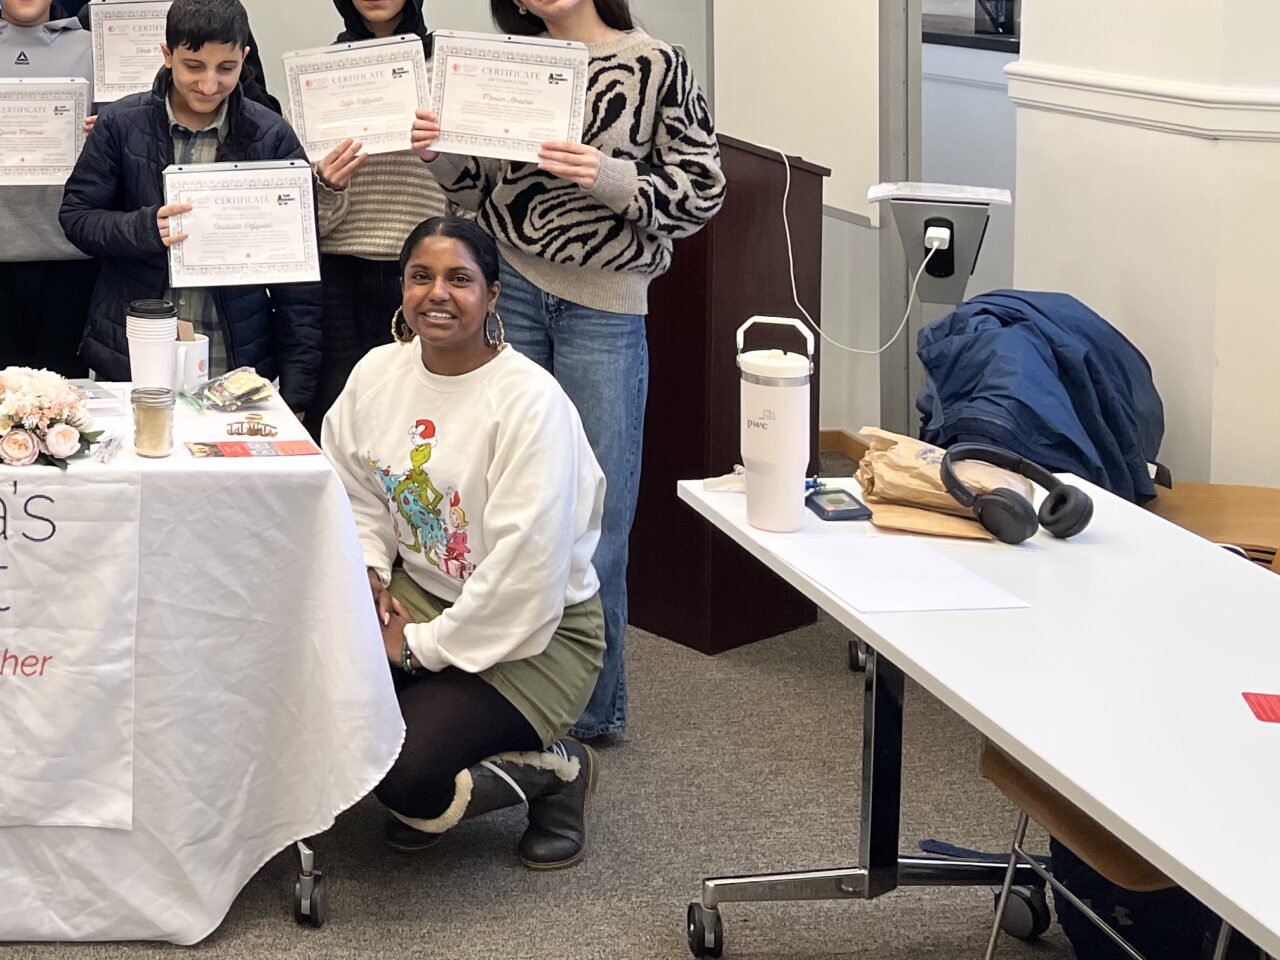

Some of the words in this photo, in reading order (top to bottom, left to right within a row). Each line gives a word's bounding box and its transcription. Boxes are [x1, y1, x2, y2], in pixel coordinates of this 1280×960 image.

[331, 70, 385, 84] CERTIFICATE
[481, 66, 541, 80] CERTIFICATE
[214, 195, 270, 205] CERTIFICATE
[746, 419, 769, 430] pwc
